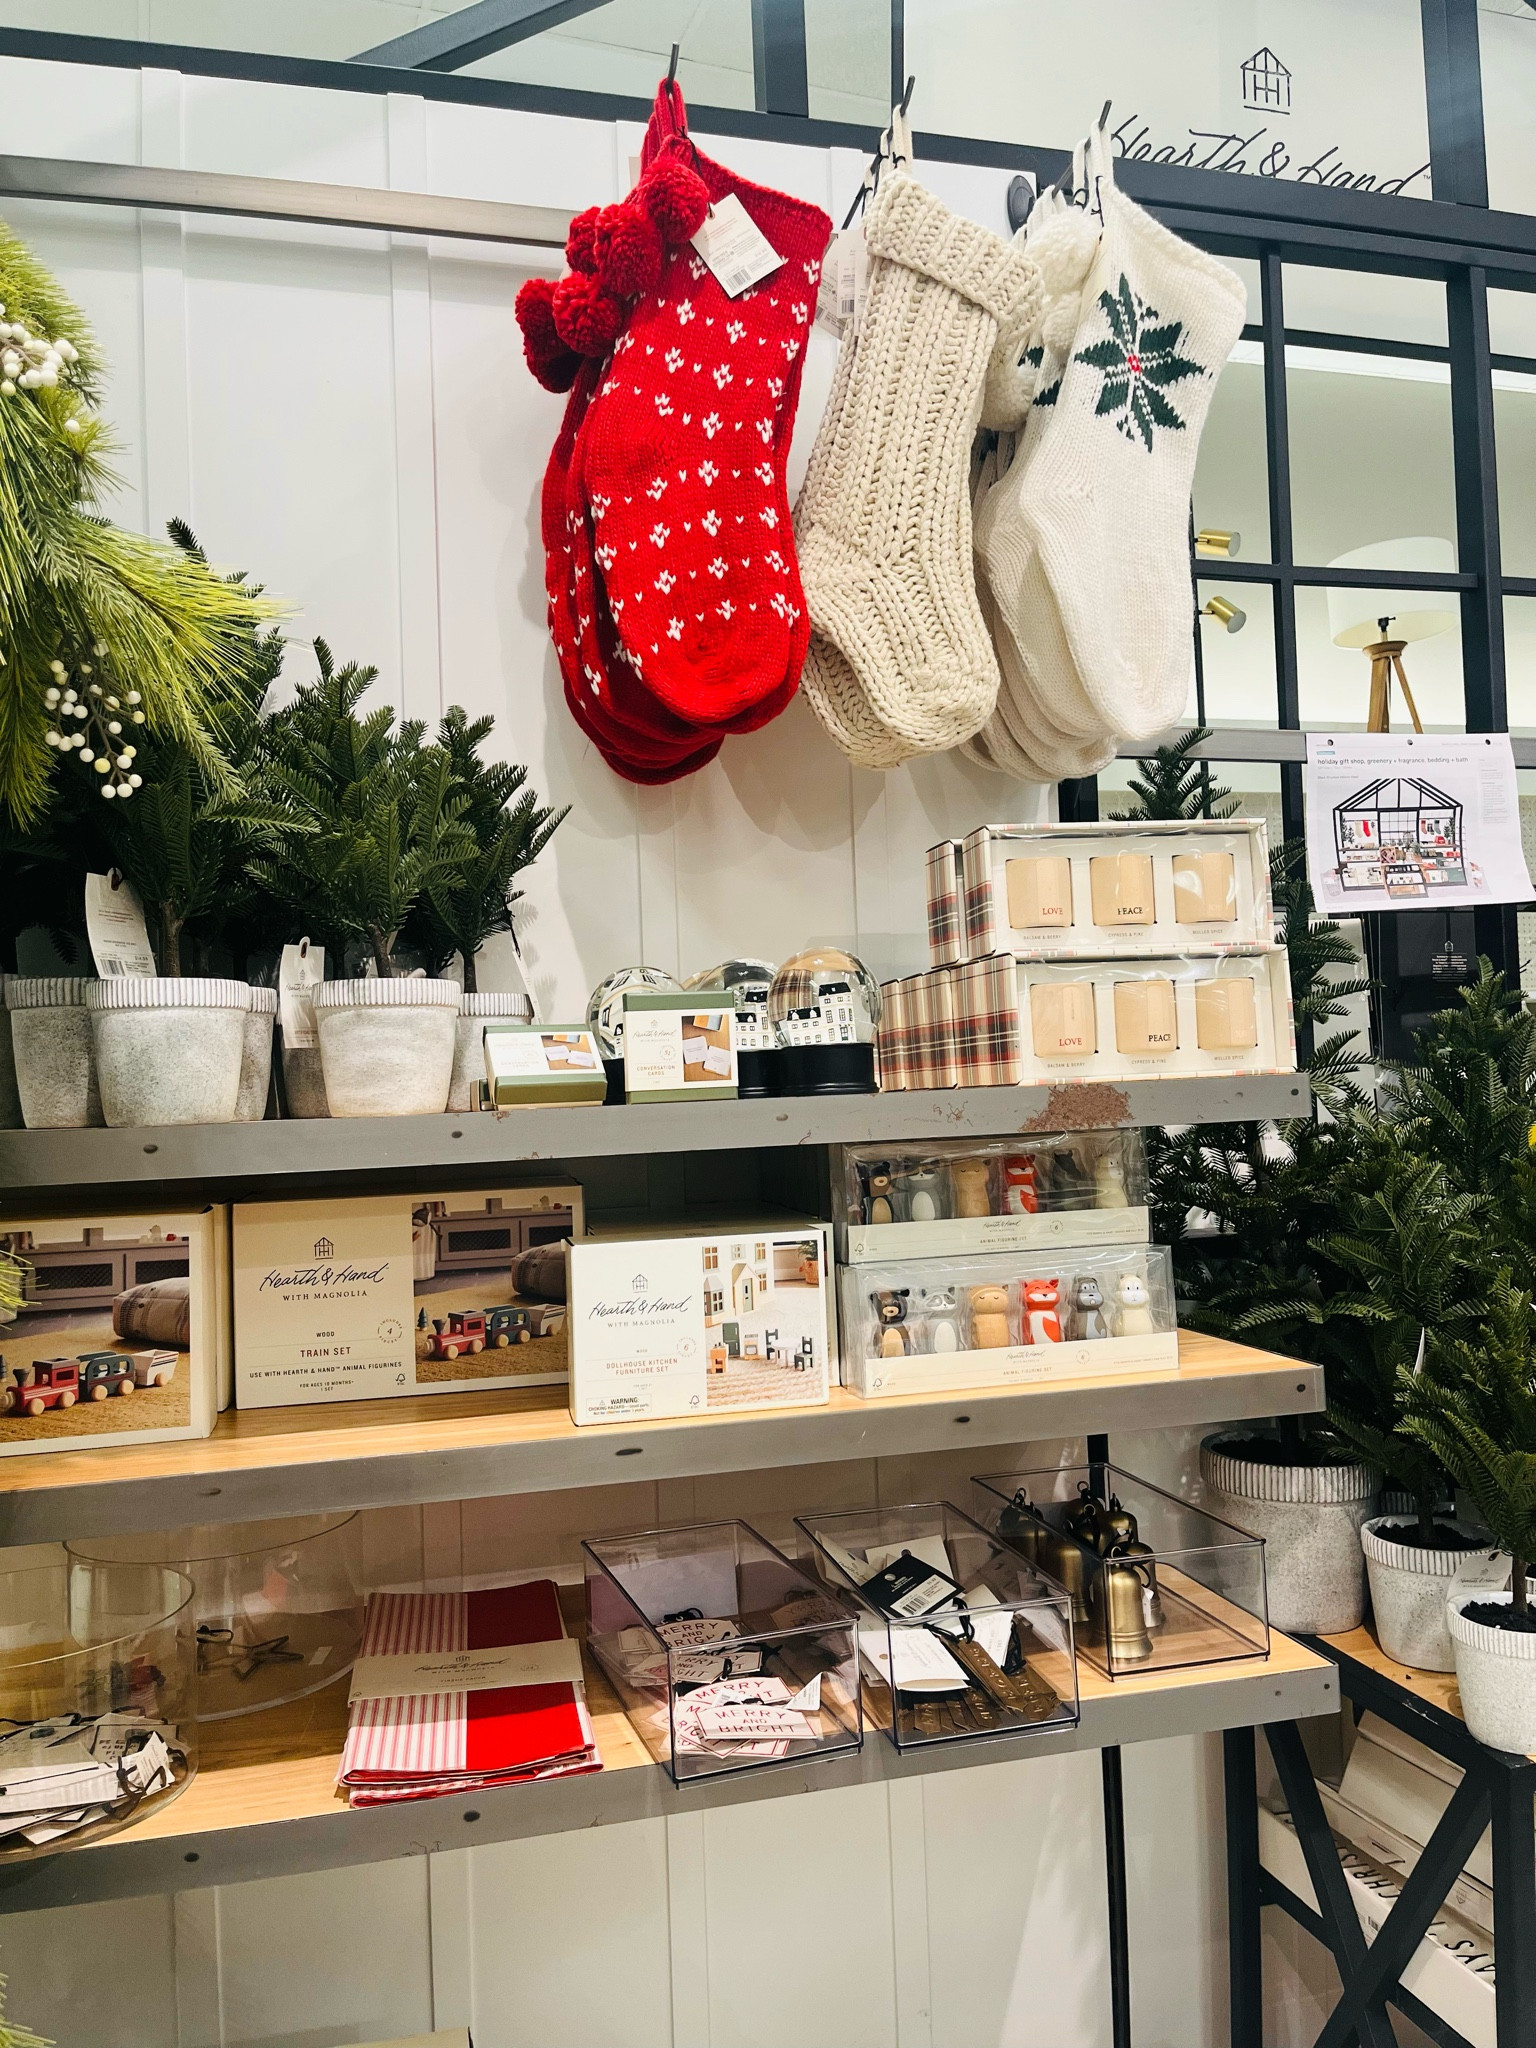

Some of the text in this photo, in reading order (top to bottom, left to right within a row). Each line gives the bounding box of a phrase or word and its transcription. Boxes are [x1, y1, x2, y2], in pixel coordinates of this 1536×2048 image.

[1111, 115, 1267, 175] Hearth
[1259, 142, 1289, 177] &
[1298, 147, 1430, 195] Hand
[1042, 907, 1063, 915] LOVE
[1059, 1038, 1082, 1046] LOVE
[1148, 1034, 1171, 1042] PEACE
[259, 1263, 389, 1291] Hearth & Hand
[314, 1290, 367, 1299] MAGNOLIA
[589, 1296, 692, 1320] Hearth & Hand
[633, 1318, 675, 1326] MAGNOLIA
[300, 1346, 351, 1358] TRAIN SET
[368, 1361, 402, 1369] FIGURINES
[606, 1358, 678, 1369] DOLLHOUSE KITCHEN
[616, 1367, 653, 1376] FURNITURE
[660, 1622, 719, 1637] MERRY
[682, 1630, 703, 1638] AND
[667, 1634, 715, 1648] BRIG
[715, 1709, 786, 1719] MERRY
[718, 1725, 795, 1733] BRIGHT
